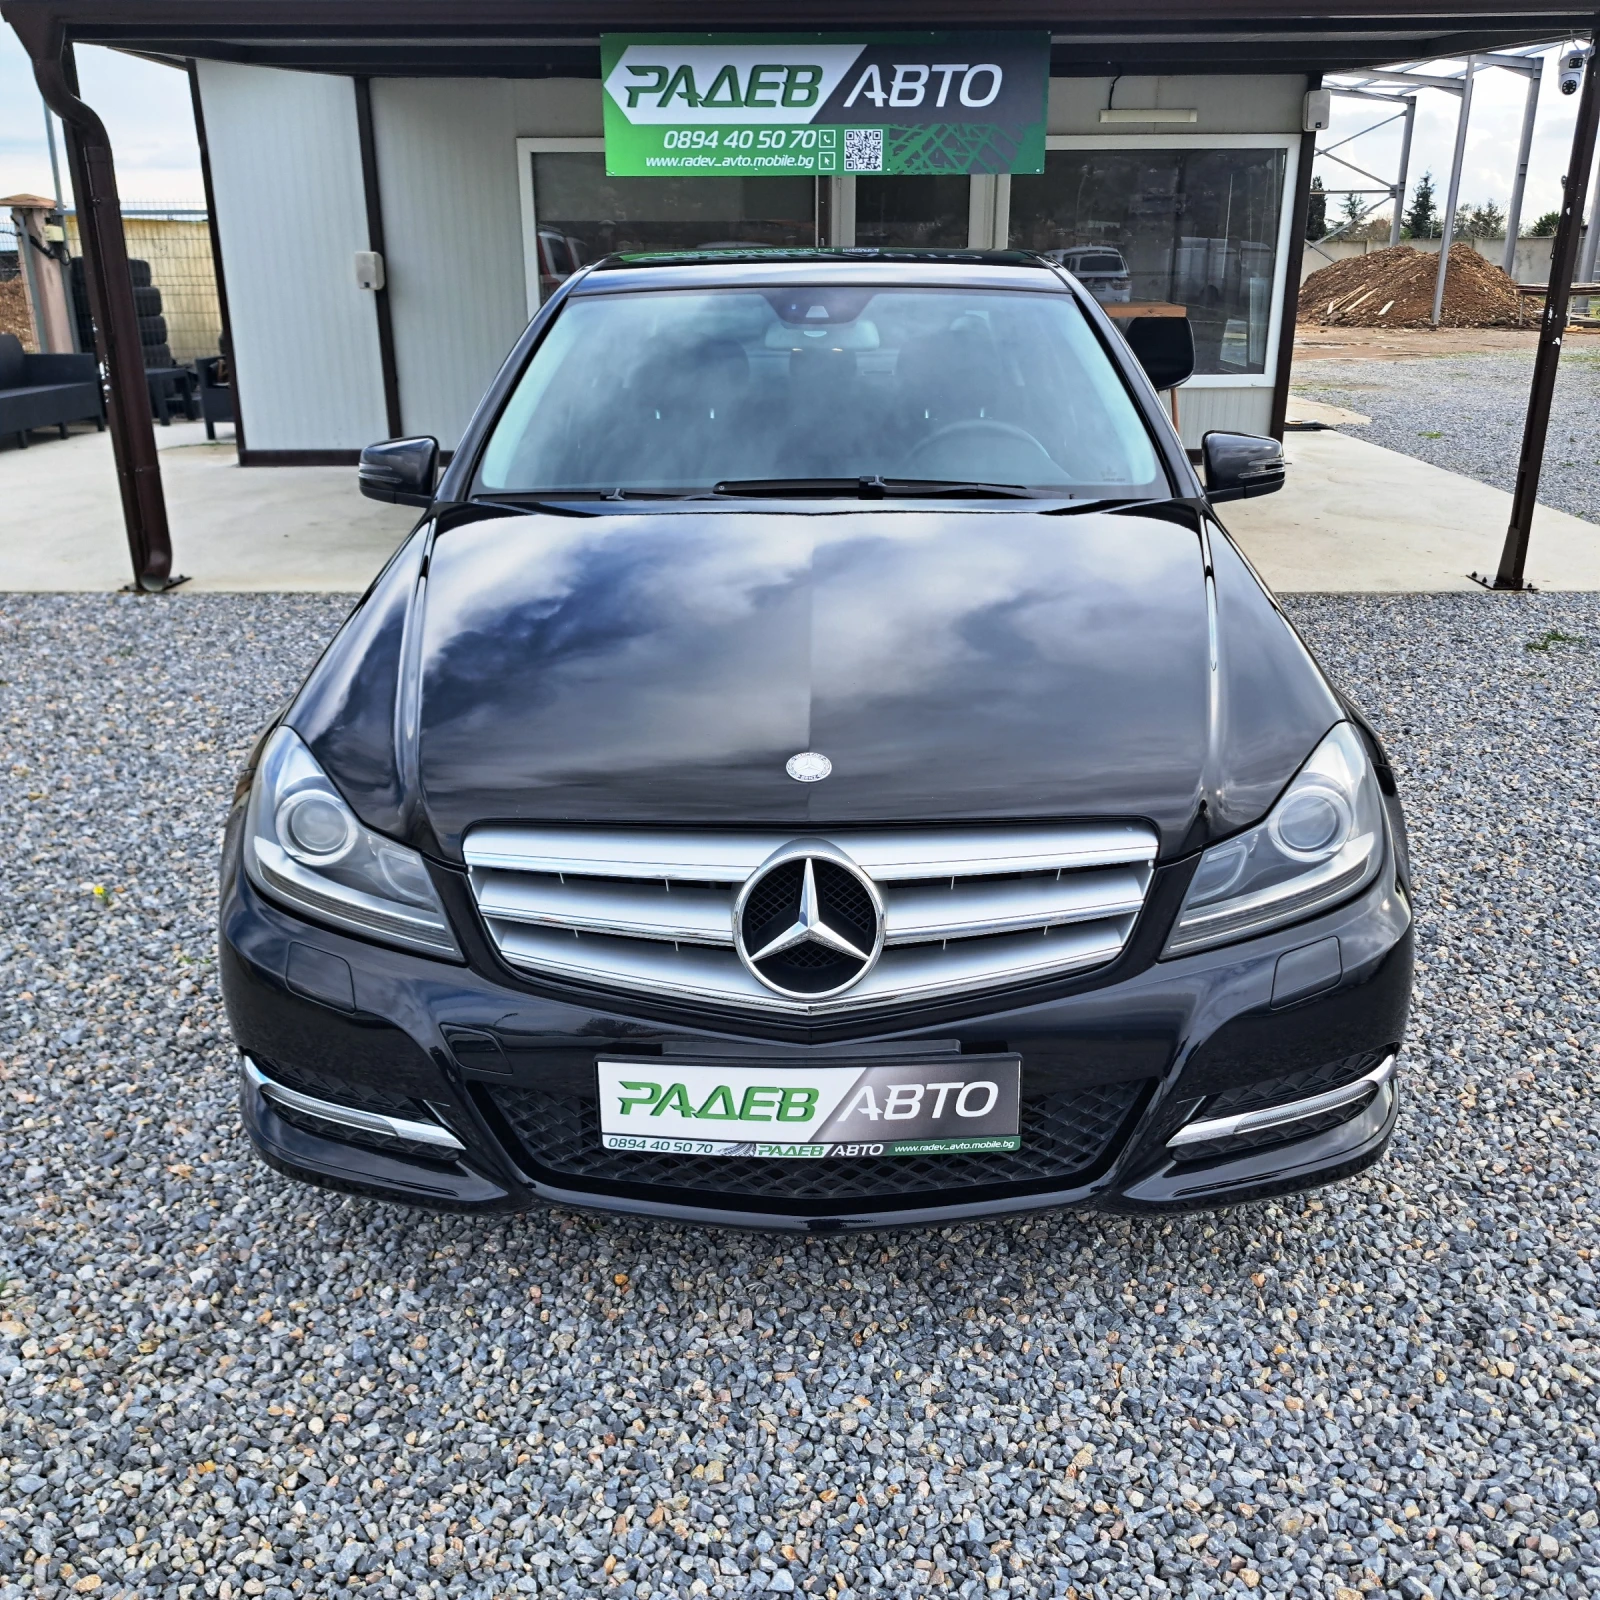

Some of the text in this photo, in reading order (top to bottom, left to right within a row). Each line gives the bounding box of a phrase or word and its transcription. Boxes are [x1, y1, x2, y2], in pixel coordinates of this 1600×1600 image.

[843, 64, 1002, 107] АВТО
[663, 130, 816, 149] 0894 40 50 70
[645, 153, 814, 169] www.radev_avto.mobile.bg
[837, 1081, 998, 1121] АВТО
[608, 1138, 713, 1153] 0894 40 50 70
[831, 1144, 884, 1156] АВТО
[894, 1140, 1015, 1153] www.radev_avto.mobile.bg
